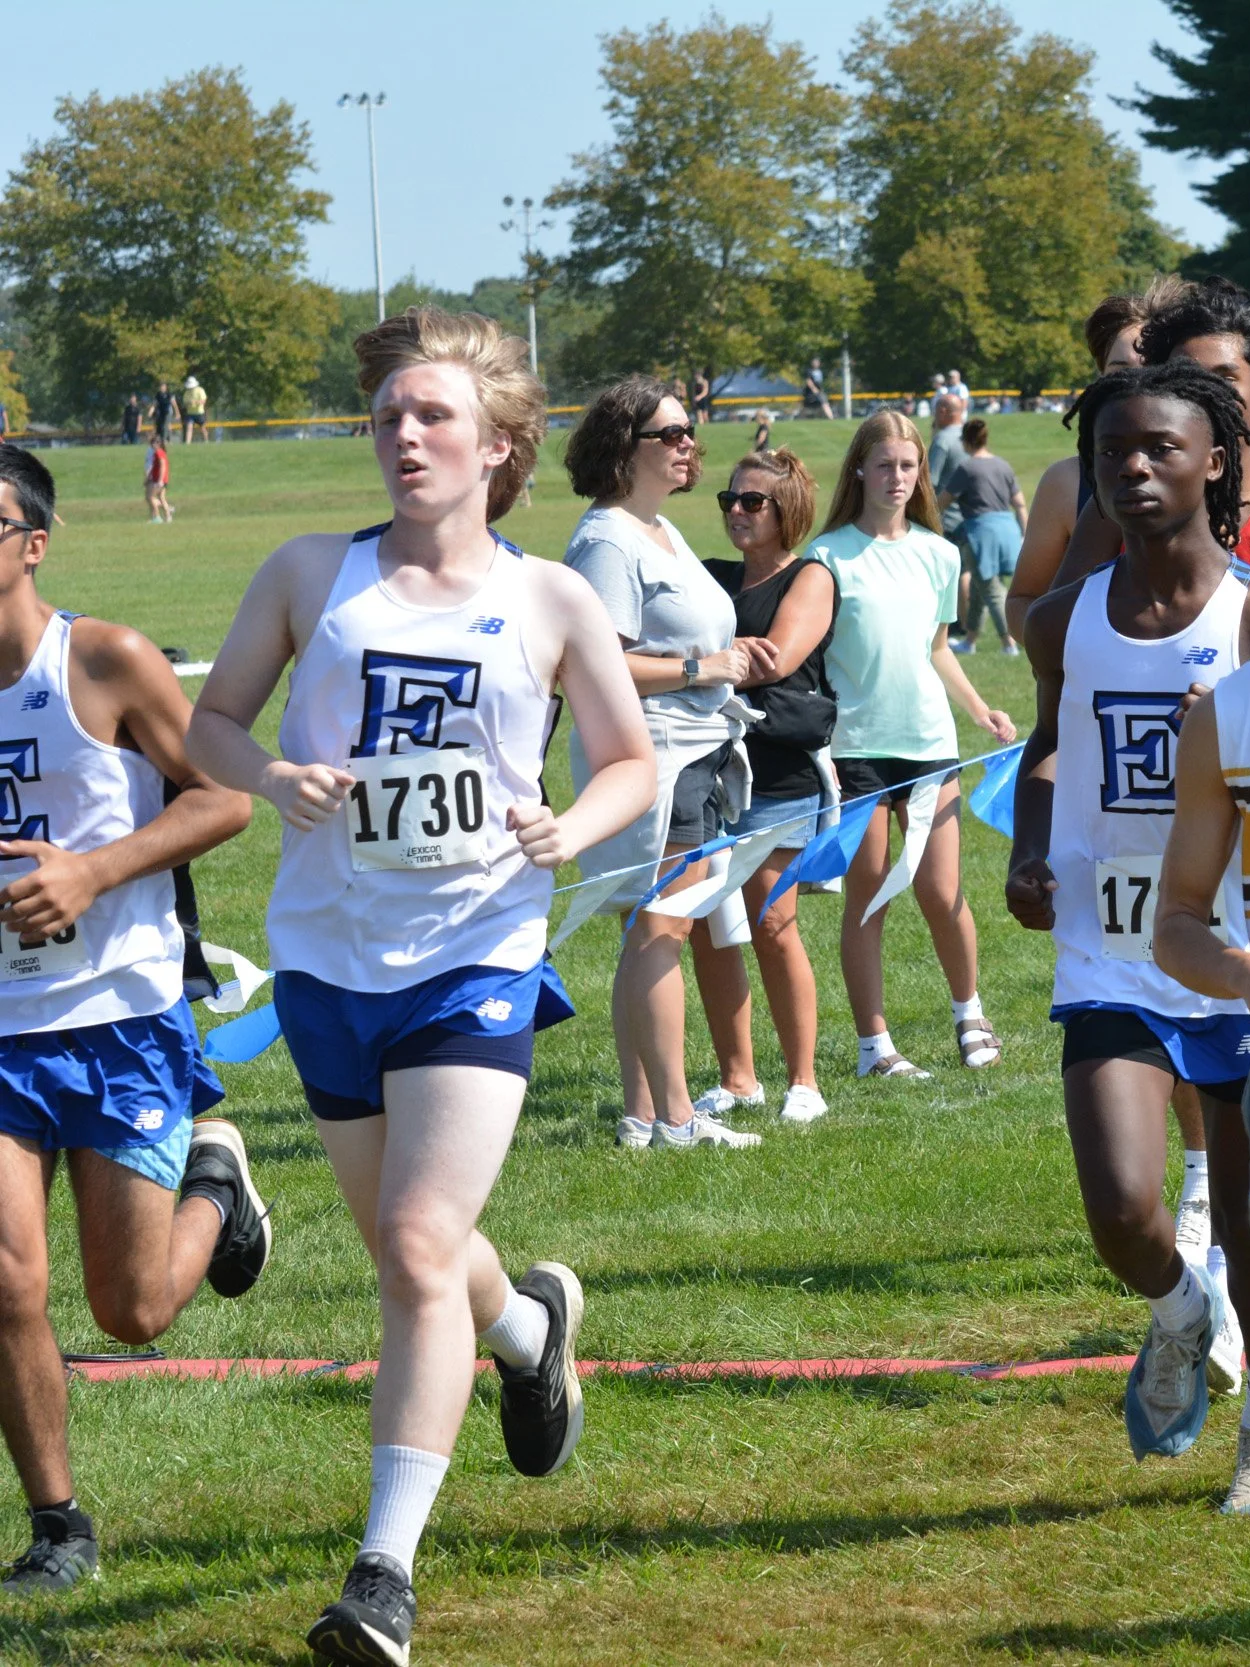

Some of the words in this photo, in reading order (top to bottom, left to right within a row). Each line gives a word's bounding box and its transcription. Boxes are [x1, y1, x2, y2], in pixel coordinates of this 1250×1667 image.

[350, 770, 483, 843] 1730
[407, 845, 442, 857] LEXICON
[415, 854, 443, 864] TIMING
[10, 956, 40, 969] LEXICON
[16, 965, 42, 974] TIMING
